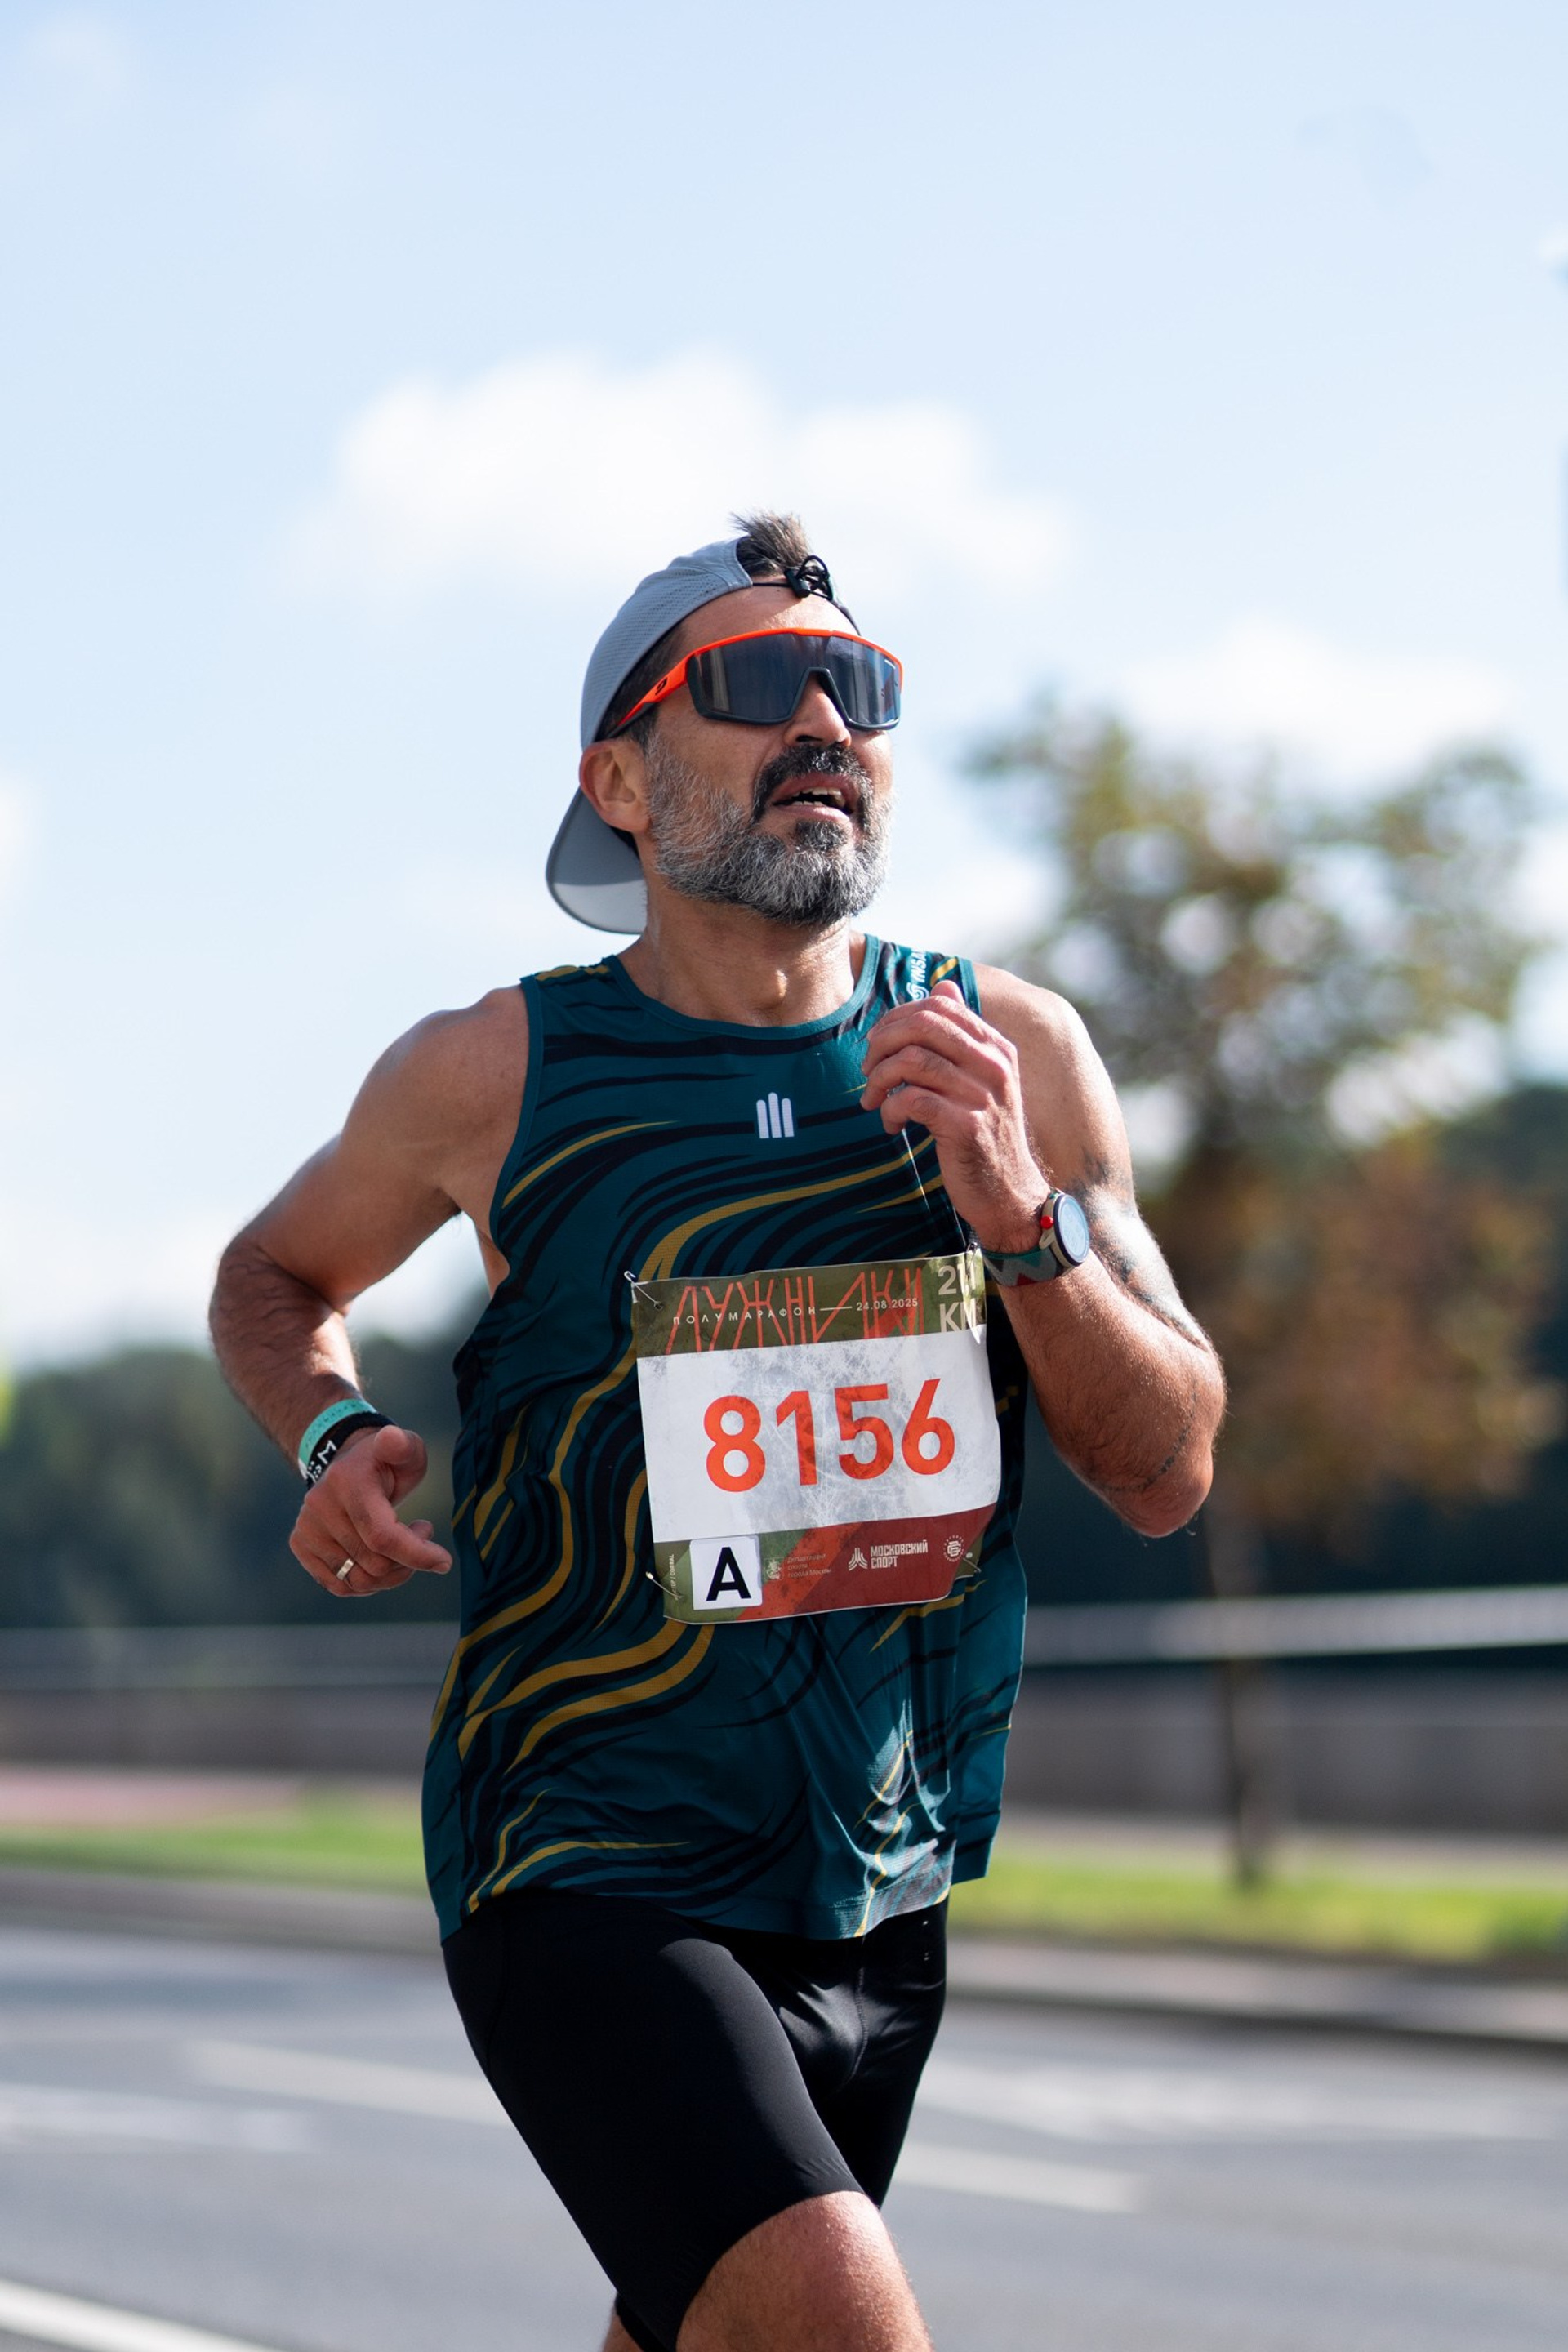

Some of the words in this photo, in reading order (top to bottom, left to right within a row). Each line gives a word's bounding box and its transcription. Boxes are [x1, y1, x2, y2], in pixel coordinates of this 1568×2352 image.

[673, 1307, 816, 1325] ПОЛУМАРАФОН
[857, 1298, 918, 1312] 24.08.2025
[703, 1378, 956, 1493] 8156
[870, 1539, 929, 1557] МОСКОВСКИЙ
[871, 1556, 898, 1569] СПОРТ
